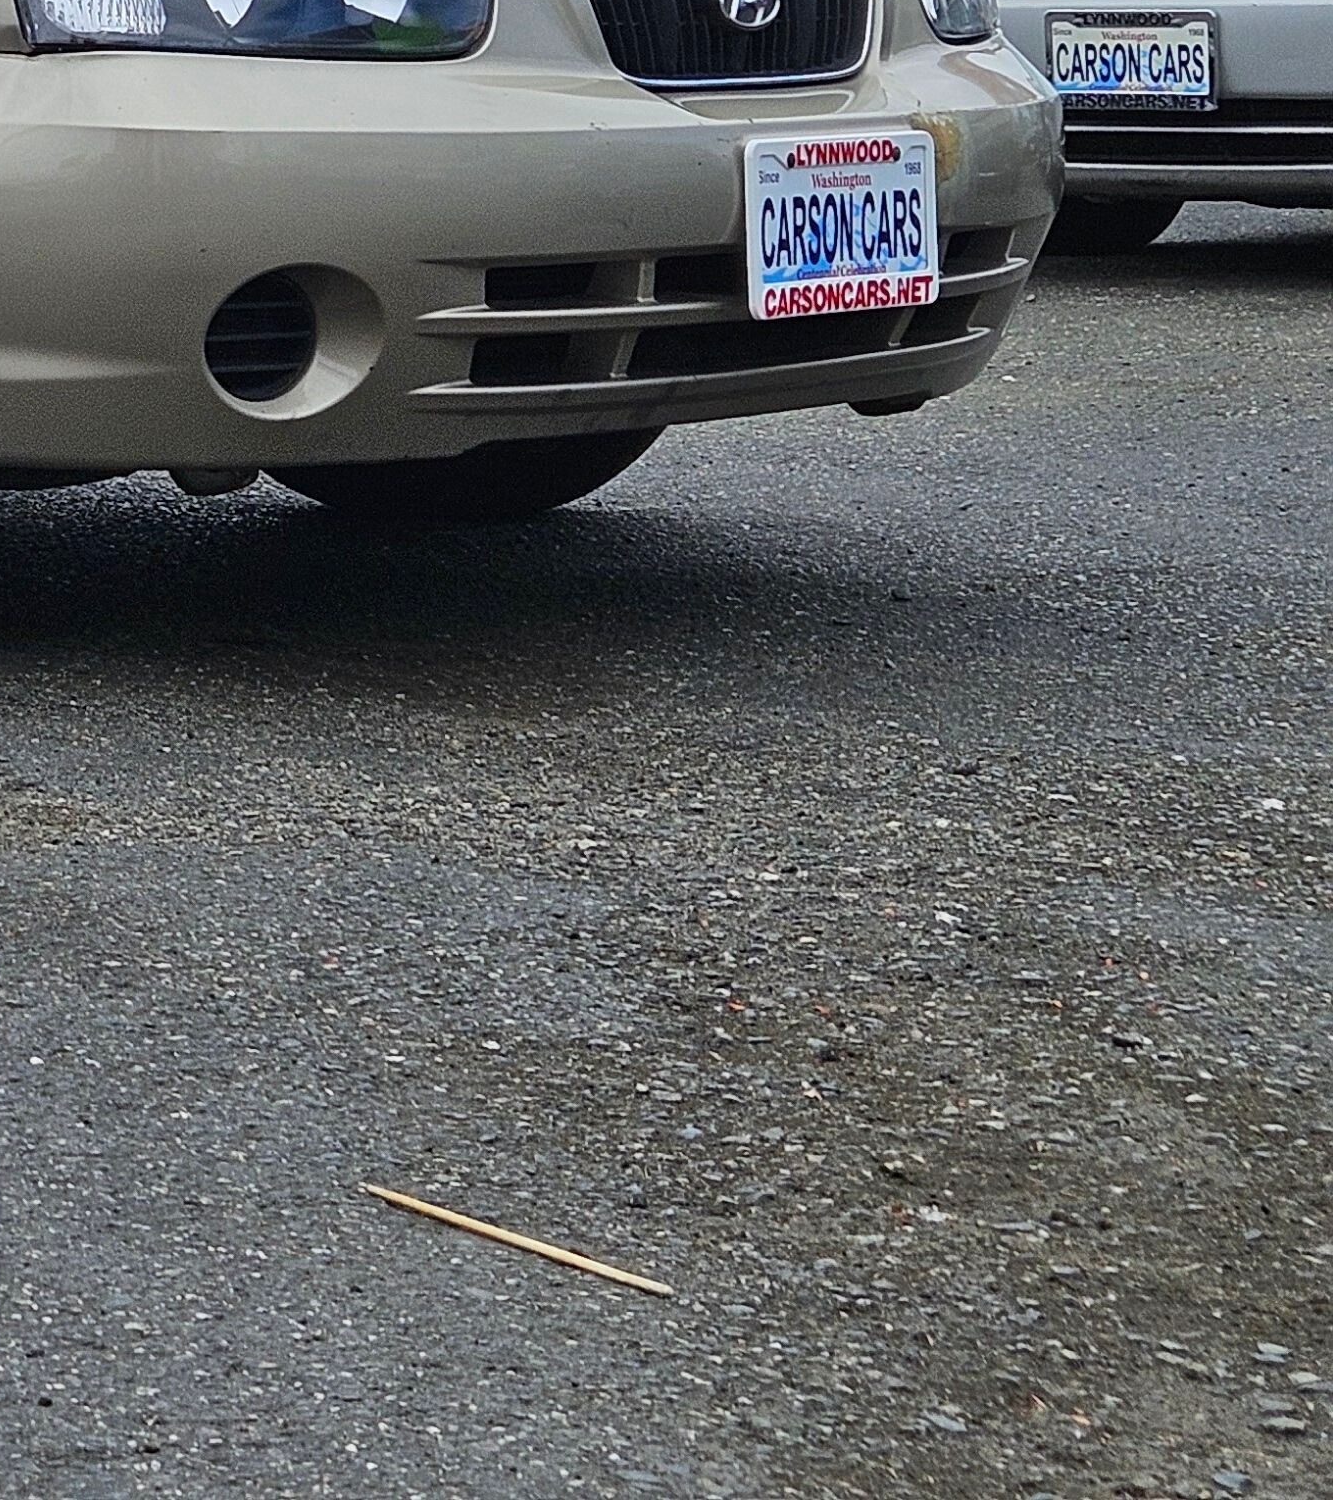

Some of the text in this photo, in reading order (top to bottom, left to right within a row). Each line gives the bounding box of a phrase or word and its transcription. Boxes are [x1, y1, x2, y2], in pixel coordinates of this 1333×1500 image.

[1101, 31, 1158, 43] Washington
[1056, 42, 1205, 84] CARSON CARS
[796, 139, 894, 167] LYNNWOOD
[758, 170, 780, 185] Since
[811, 172, 872, 190] Washington
[760, 188, 923, 269] CARSON CARS
[764, 275, 934, 318] CARSONCARS.NET
